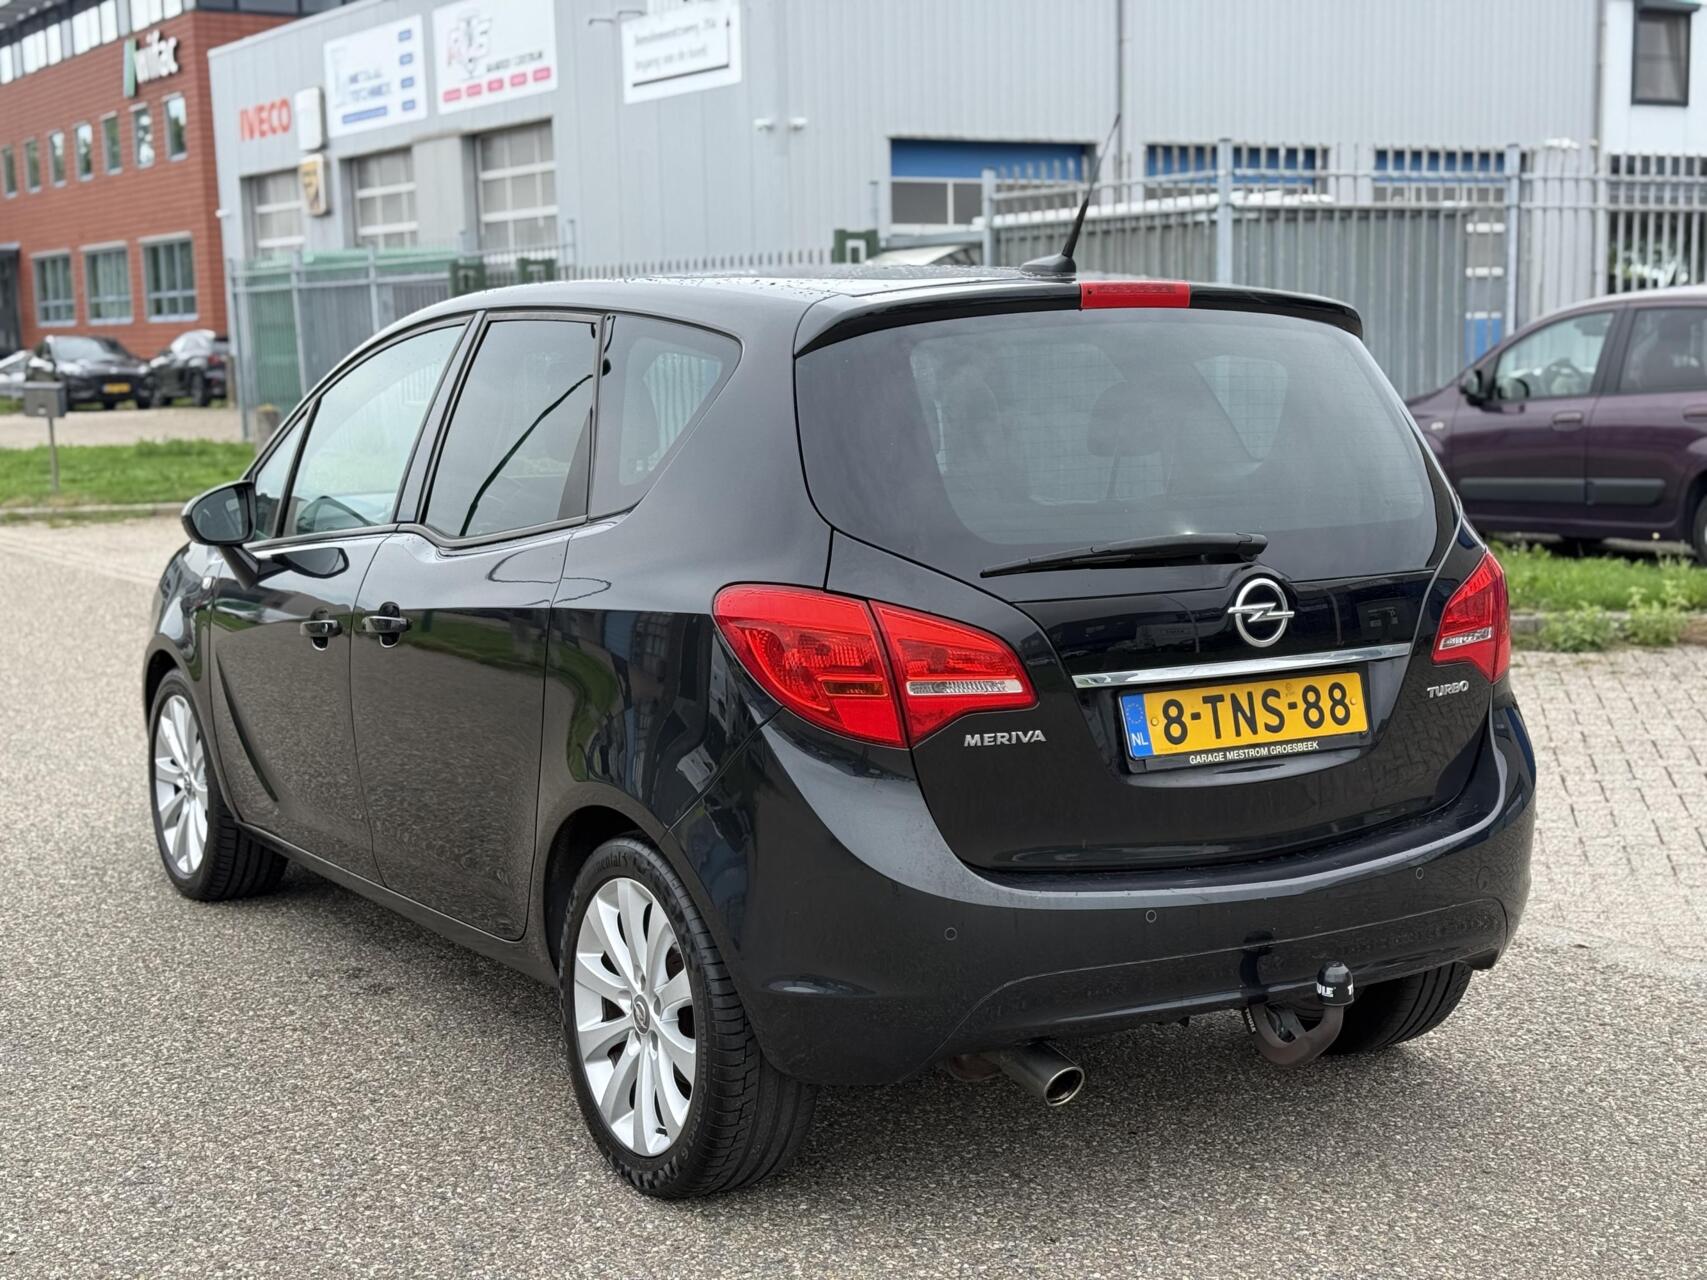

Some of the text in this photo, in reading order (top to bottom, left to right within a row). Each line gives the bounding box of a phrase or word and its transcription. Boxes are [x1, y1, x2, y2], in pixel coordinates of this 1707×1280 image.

[240, 98, 291, 142] IVECO
[1427, 680, 1469, 698] TURBO
[1162, 682, 1350, 745] 8-TNS-88
[964, 730, 1047, 747] MERIVA
[1131, 733, 1149, 747] NL
[1189, 741, 1320, 765] GARAGE MESTROM GROESBEEK
